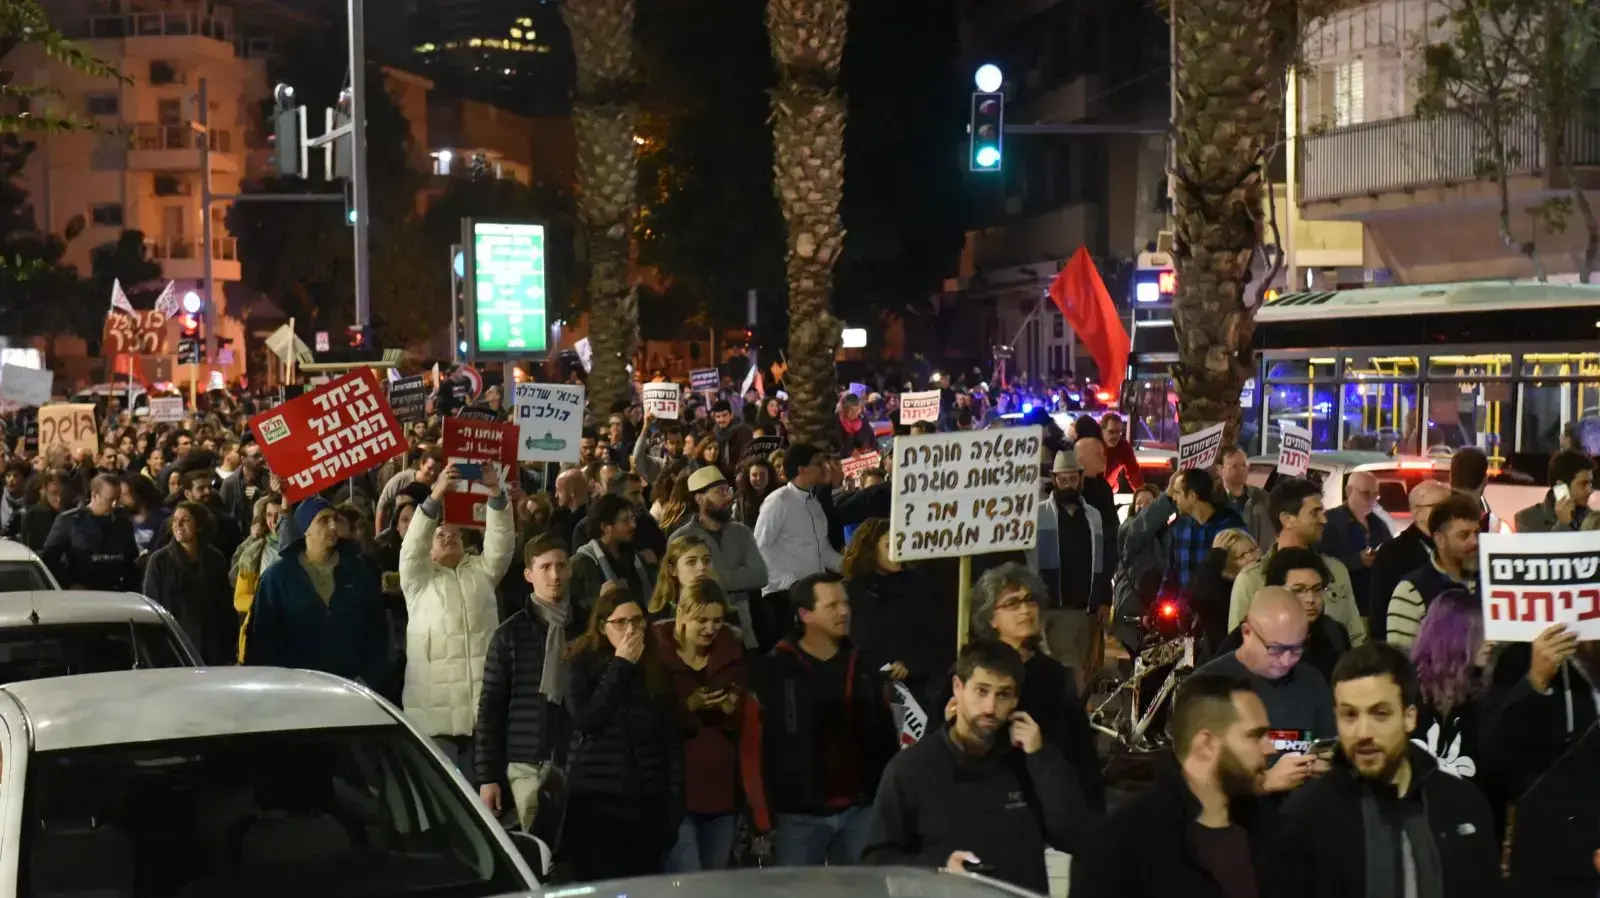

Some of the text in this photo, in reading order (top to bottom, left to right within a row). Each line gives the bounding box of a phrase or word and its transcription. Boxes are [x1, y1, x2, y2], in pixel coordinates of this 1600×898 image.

[312, 376, 370, 412] ביחד
[346, 394, 380, 423] נגן
[307, 411, 342, 436] על
[520, 402, 571, 421] הולכים
[902, 406, 938, 419] הביתה
[41, 411, 97, 443] בושה
[306, 412, 389, 461] המרחב
[287, 430, 398, 489] הדמוקרטי
[899, 440, 962, 468] חוקרת
[900, 460, 1038, 496] המציאות סוגרת
[971, 492, 1034, 521] ועכשיו
[1491, 556, 1600, 581] שחתים
[1490, 589, 1600, 622] ביתה
